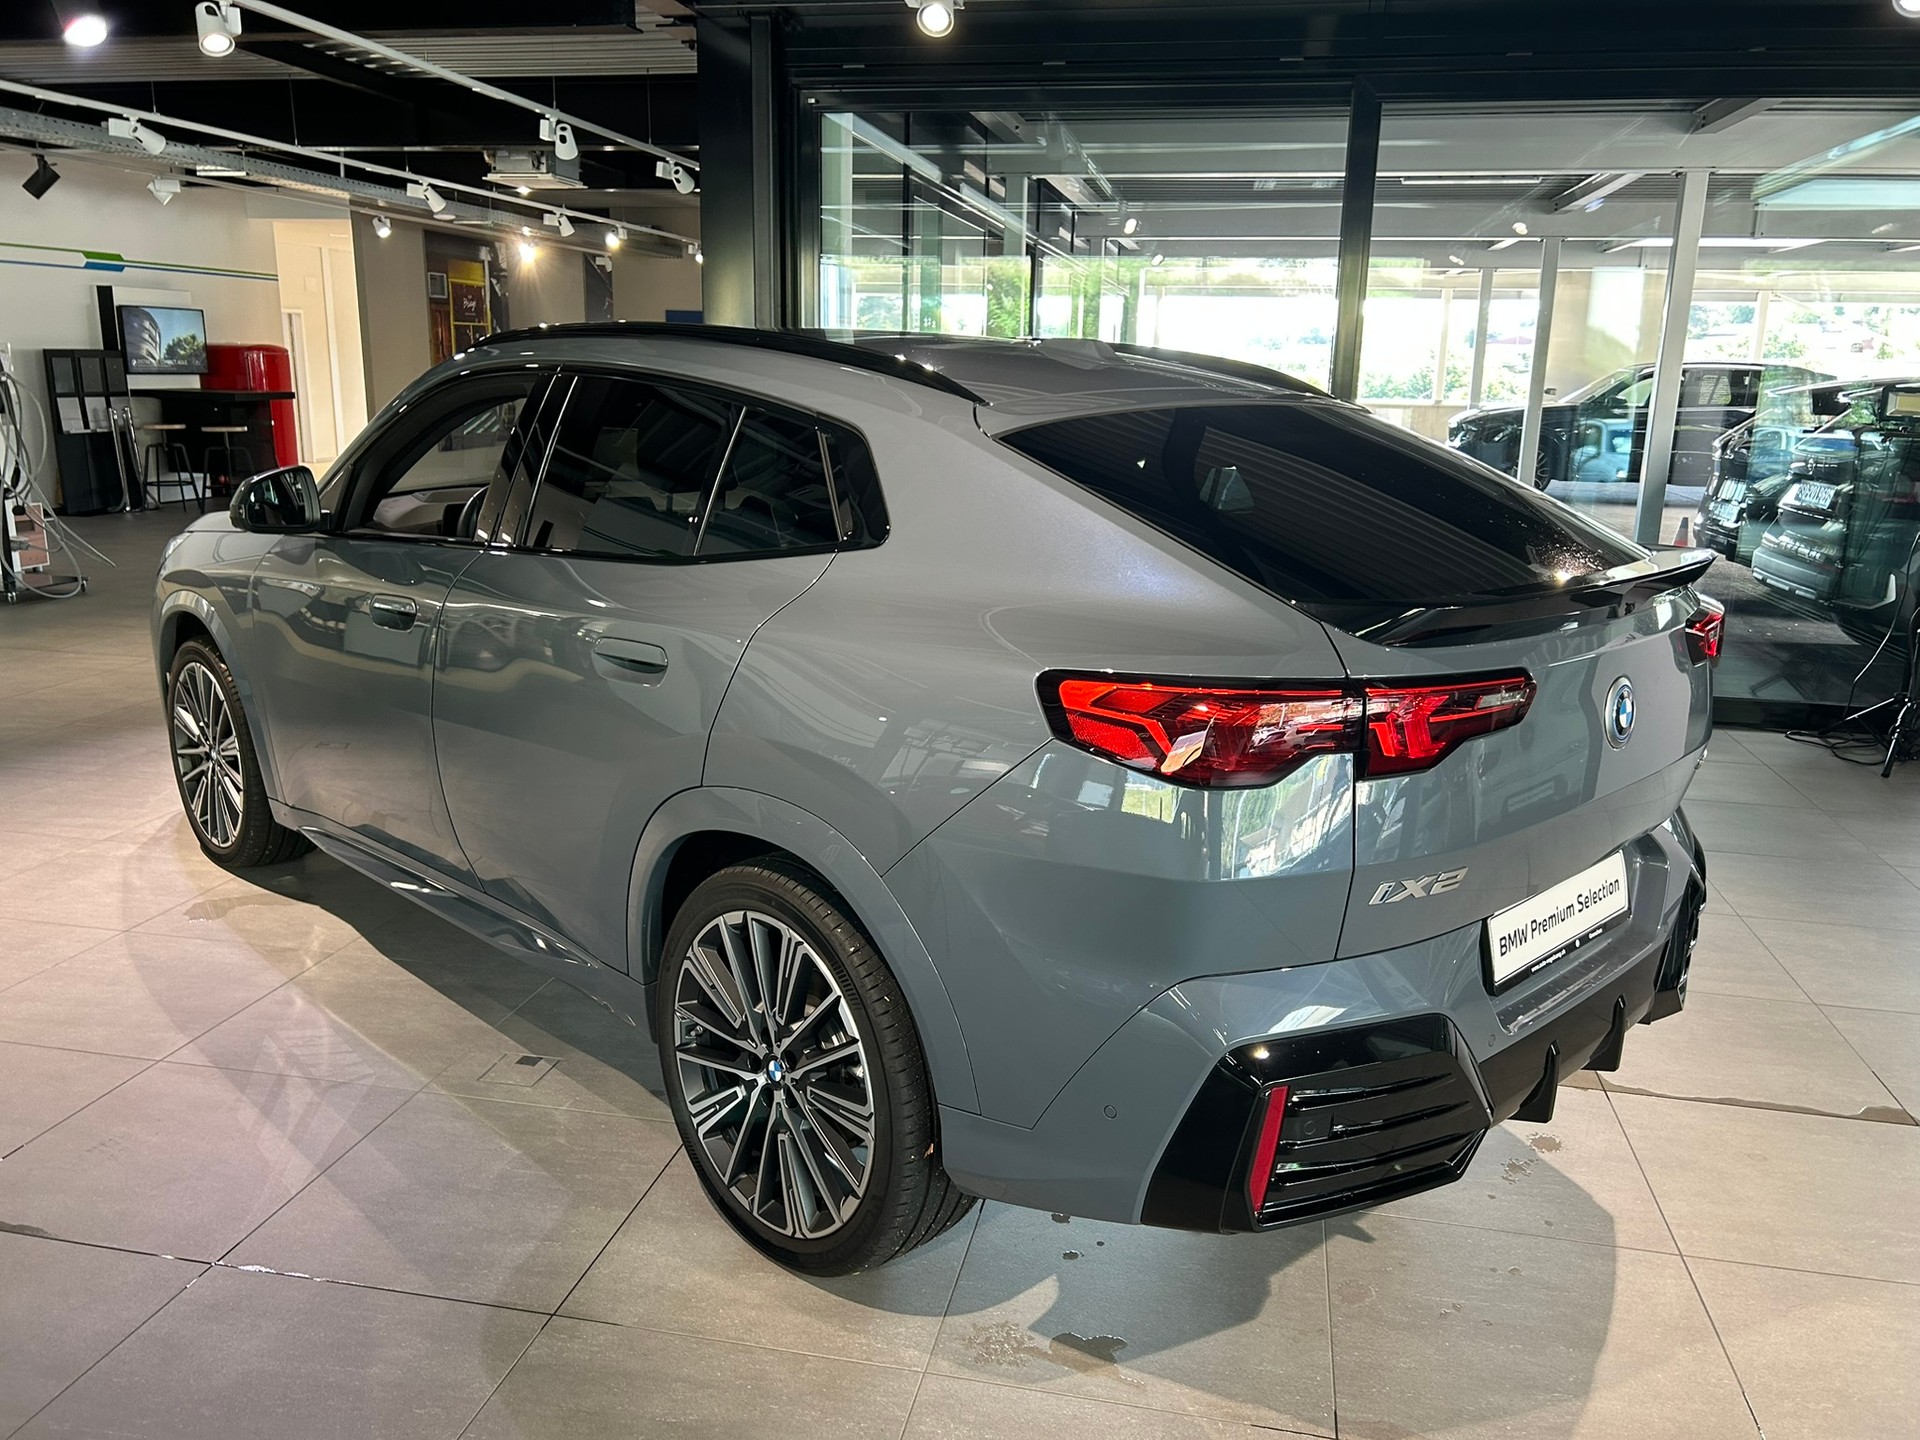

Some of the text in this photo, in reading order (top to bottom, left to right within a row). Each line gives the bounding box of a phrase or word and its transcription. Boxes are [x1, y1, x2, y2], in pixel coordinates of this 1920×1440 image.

[1499, 879, 1620, 957] BMW Premium Selection
